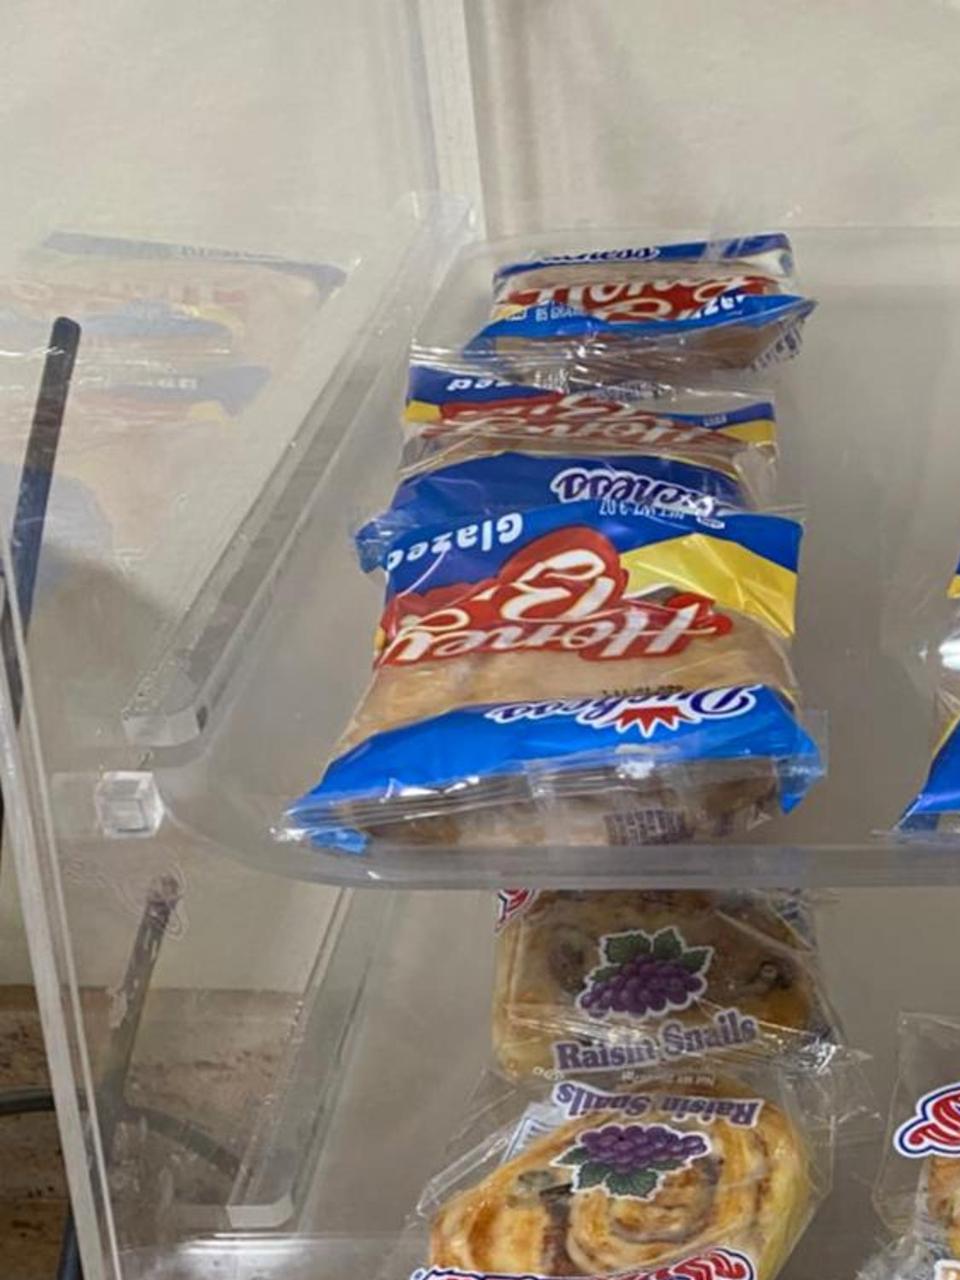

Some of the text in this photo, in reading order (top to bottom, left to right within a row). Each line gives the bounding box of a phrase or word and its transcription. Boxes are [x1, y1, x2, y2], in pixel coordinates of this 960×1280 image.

[385, 600, 717, 661] Honey
[556, 1010, 757, 1070] Raisin Snails
[556, 1083, 758, 1126] Raisin Snails
